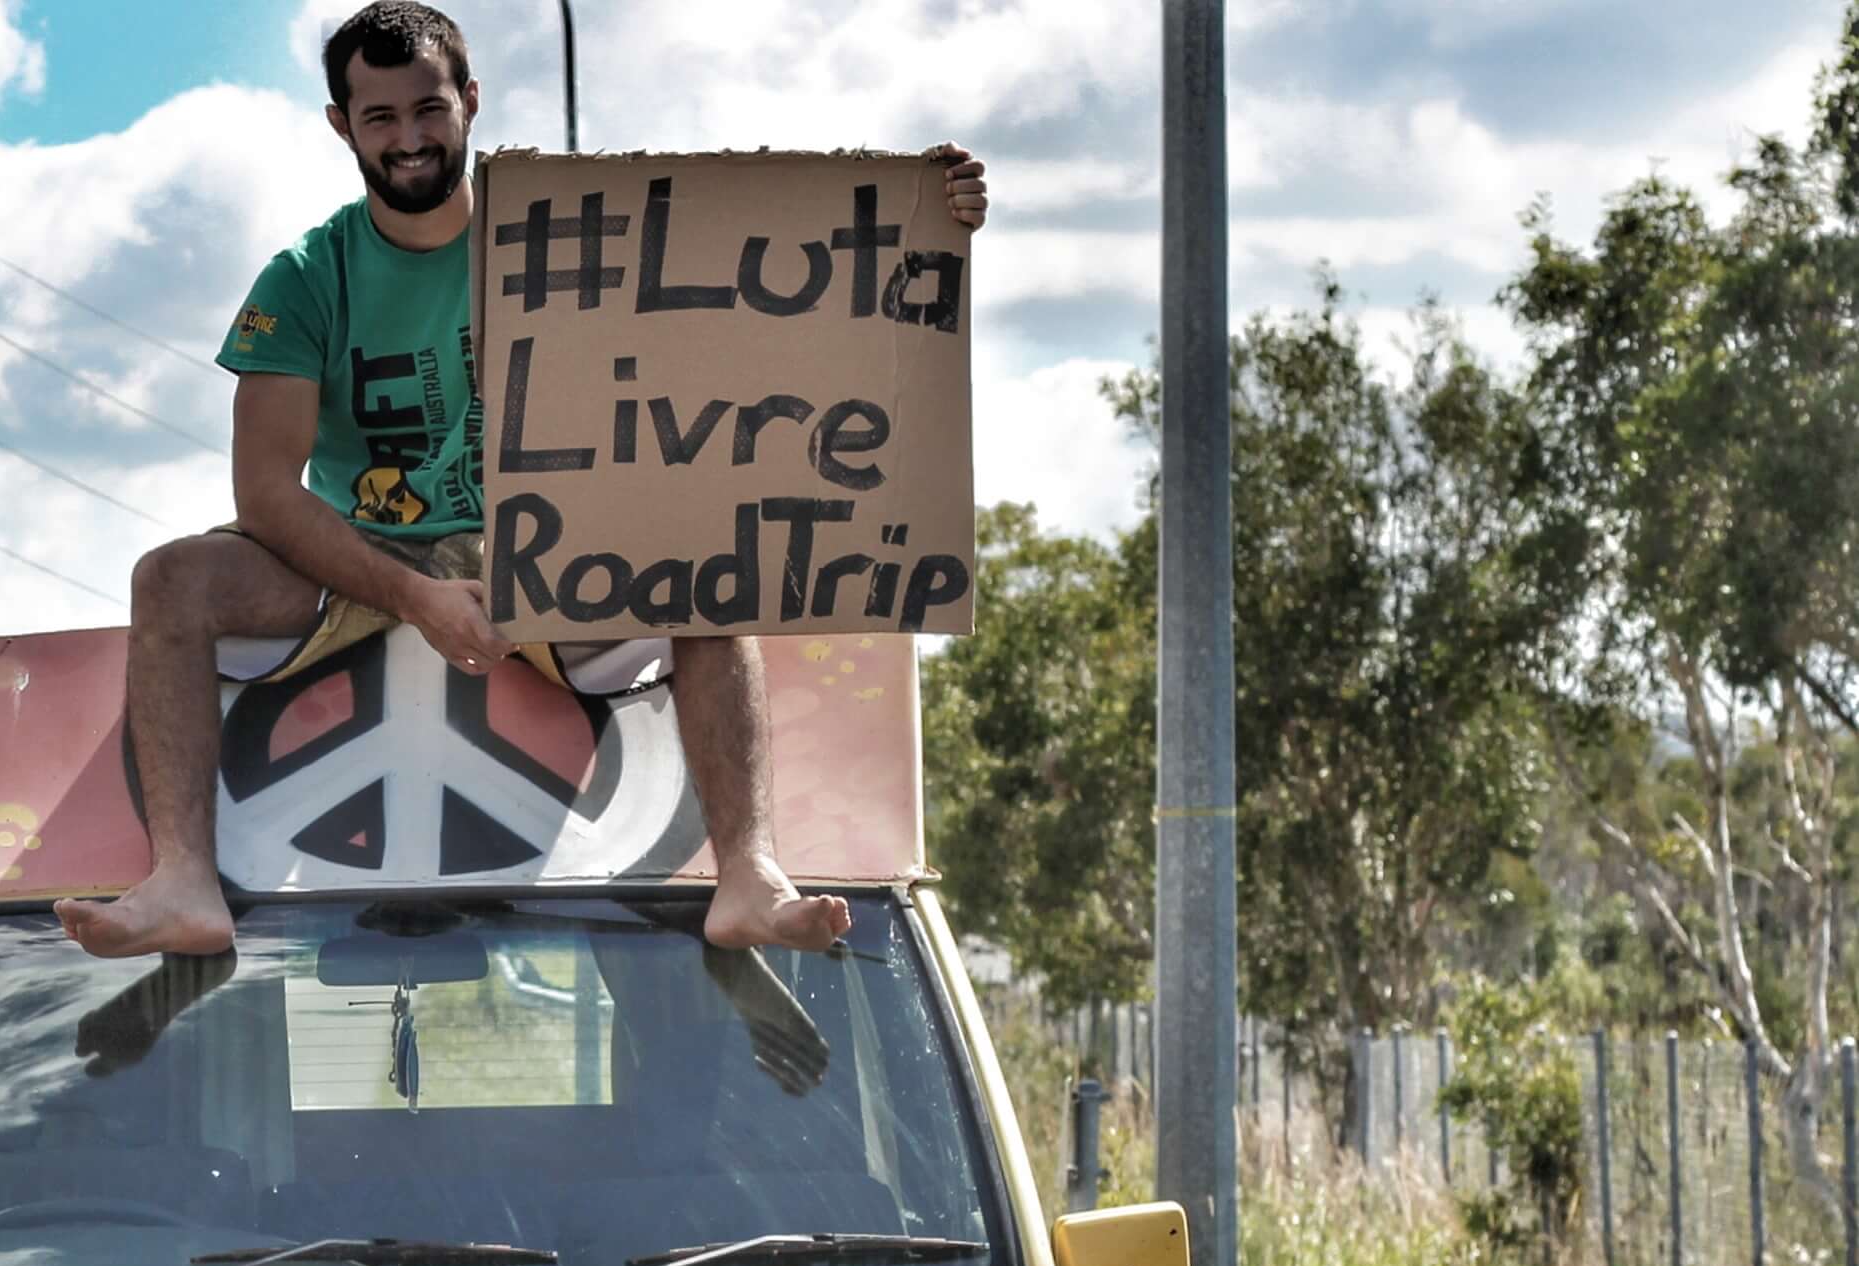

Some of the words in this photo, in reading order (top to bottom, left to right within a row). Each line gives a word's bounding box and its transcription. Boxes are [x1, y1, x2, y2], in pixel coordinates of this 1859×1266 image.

[495, 176, 964, 334] #Luta
[418, 347, 446, 424] AUSTRALIA
[498, 336, 891, 491] Livre
[490, 493, 970, 633] RoadTrip
